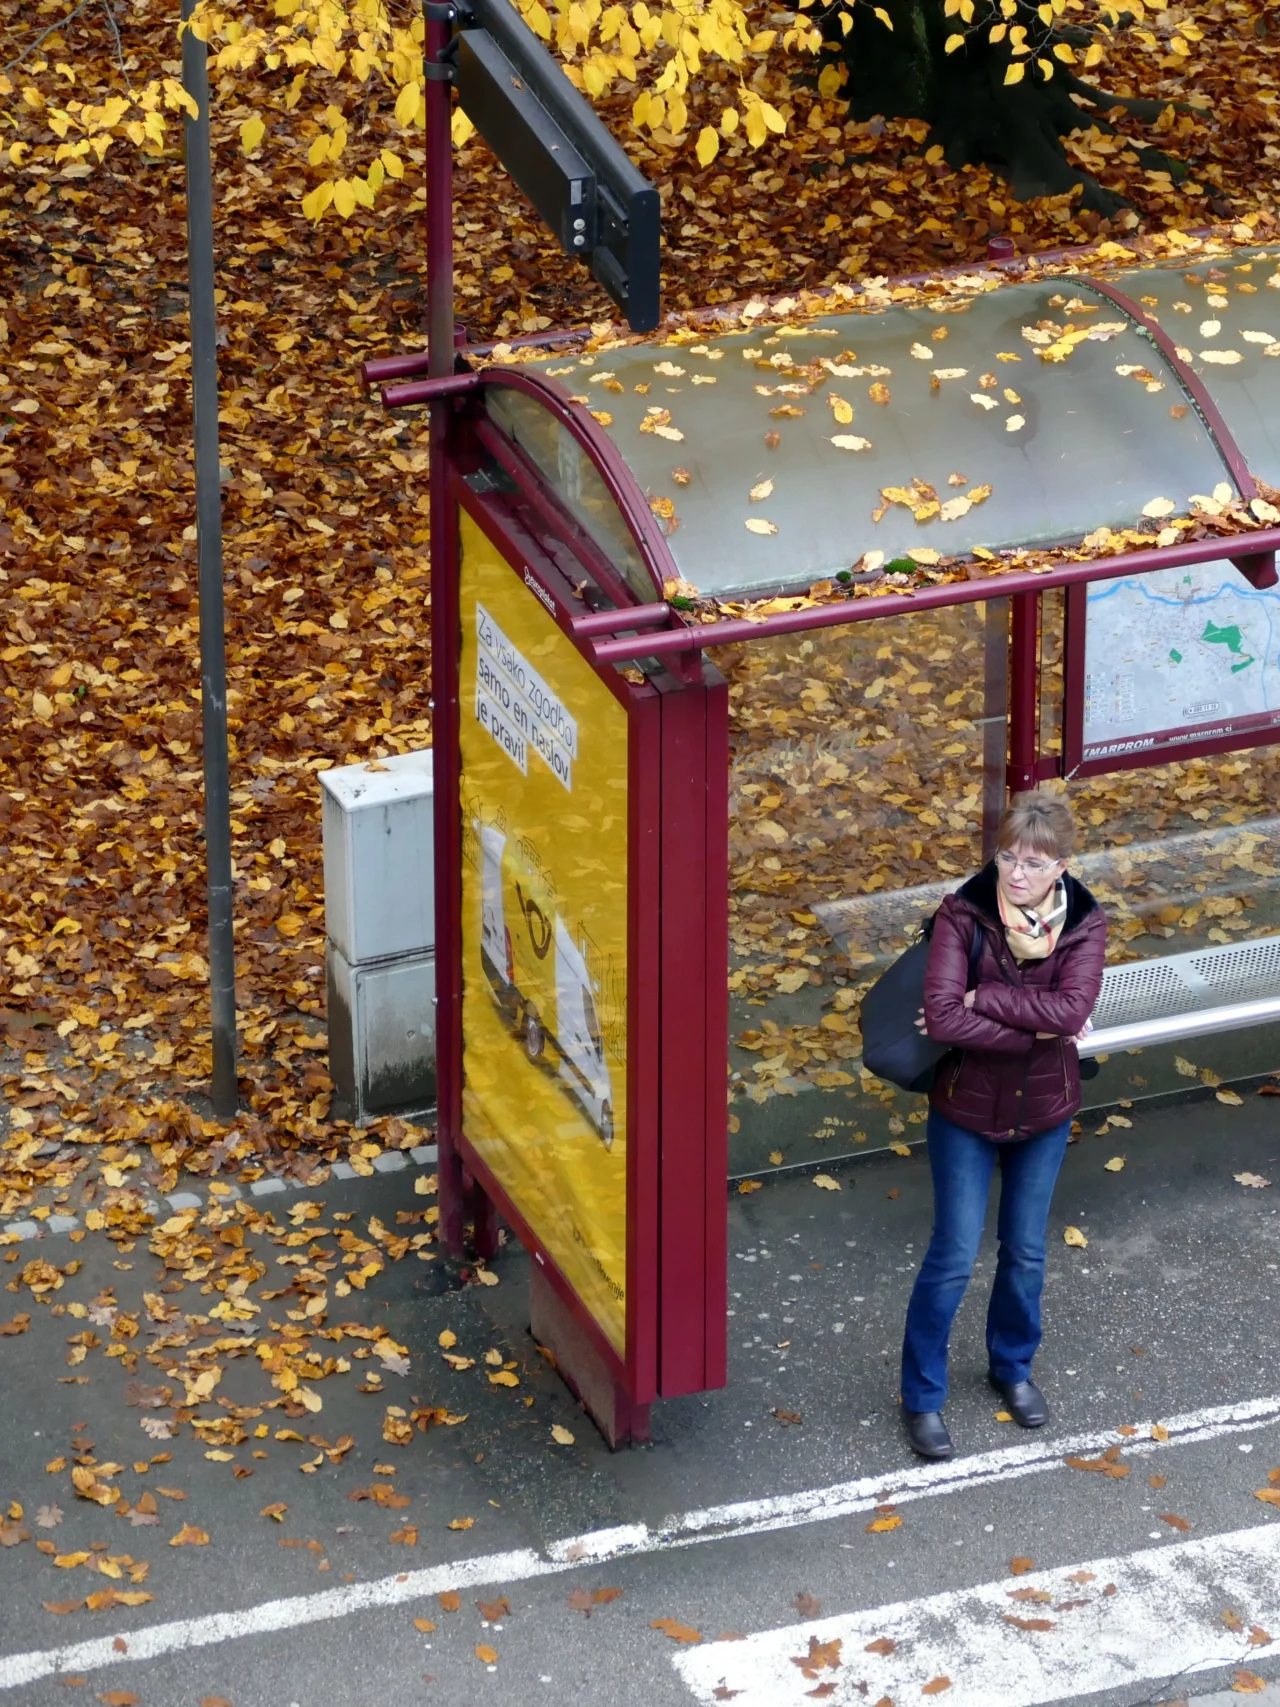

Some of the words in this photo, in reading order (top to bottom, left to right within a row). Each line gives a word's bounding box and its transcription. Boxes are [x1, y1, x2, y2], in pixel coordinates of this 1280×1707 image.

[475, 689, 488, 724] je
[490, 713, 525, 769] pravi!
[478, 609, 492, 648] Za
[495, 637, 526, 690] vsako
[528, 679, 575, 755] zgodbo,
[478, 657, 510, 709] samo
[513, 702, 528, 733] en
[531, 723, 569, 783] naslov
[1089, 737, 1154, 757] MARPROM
